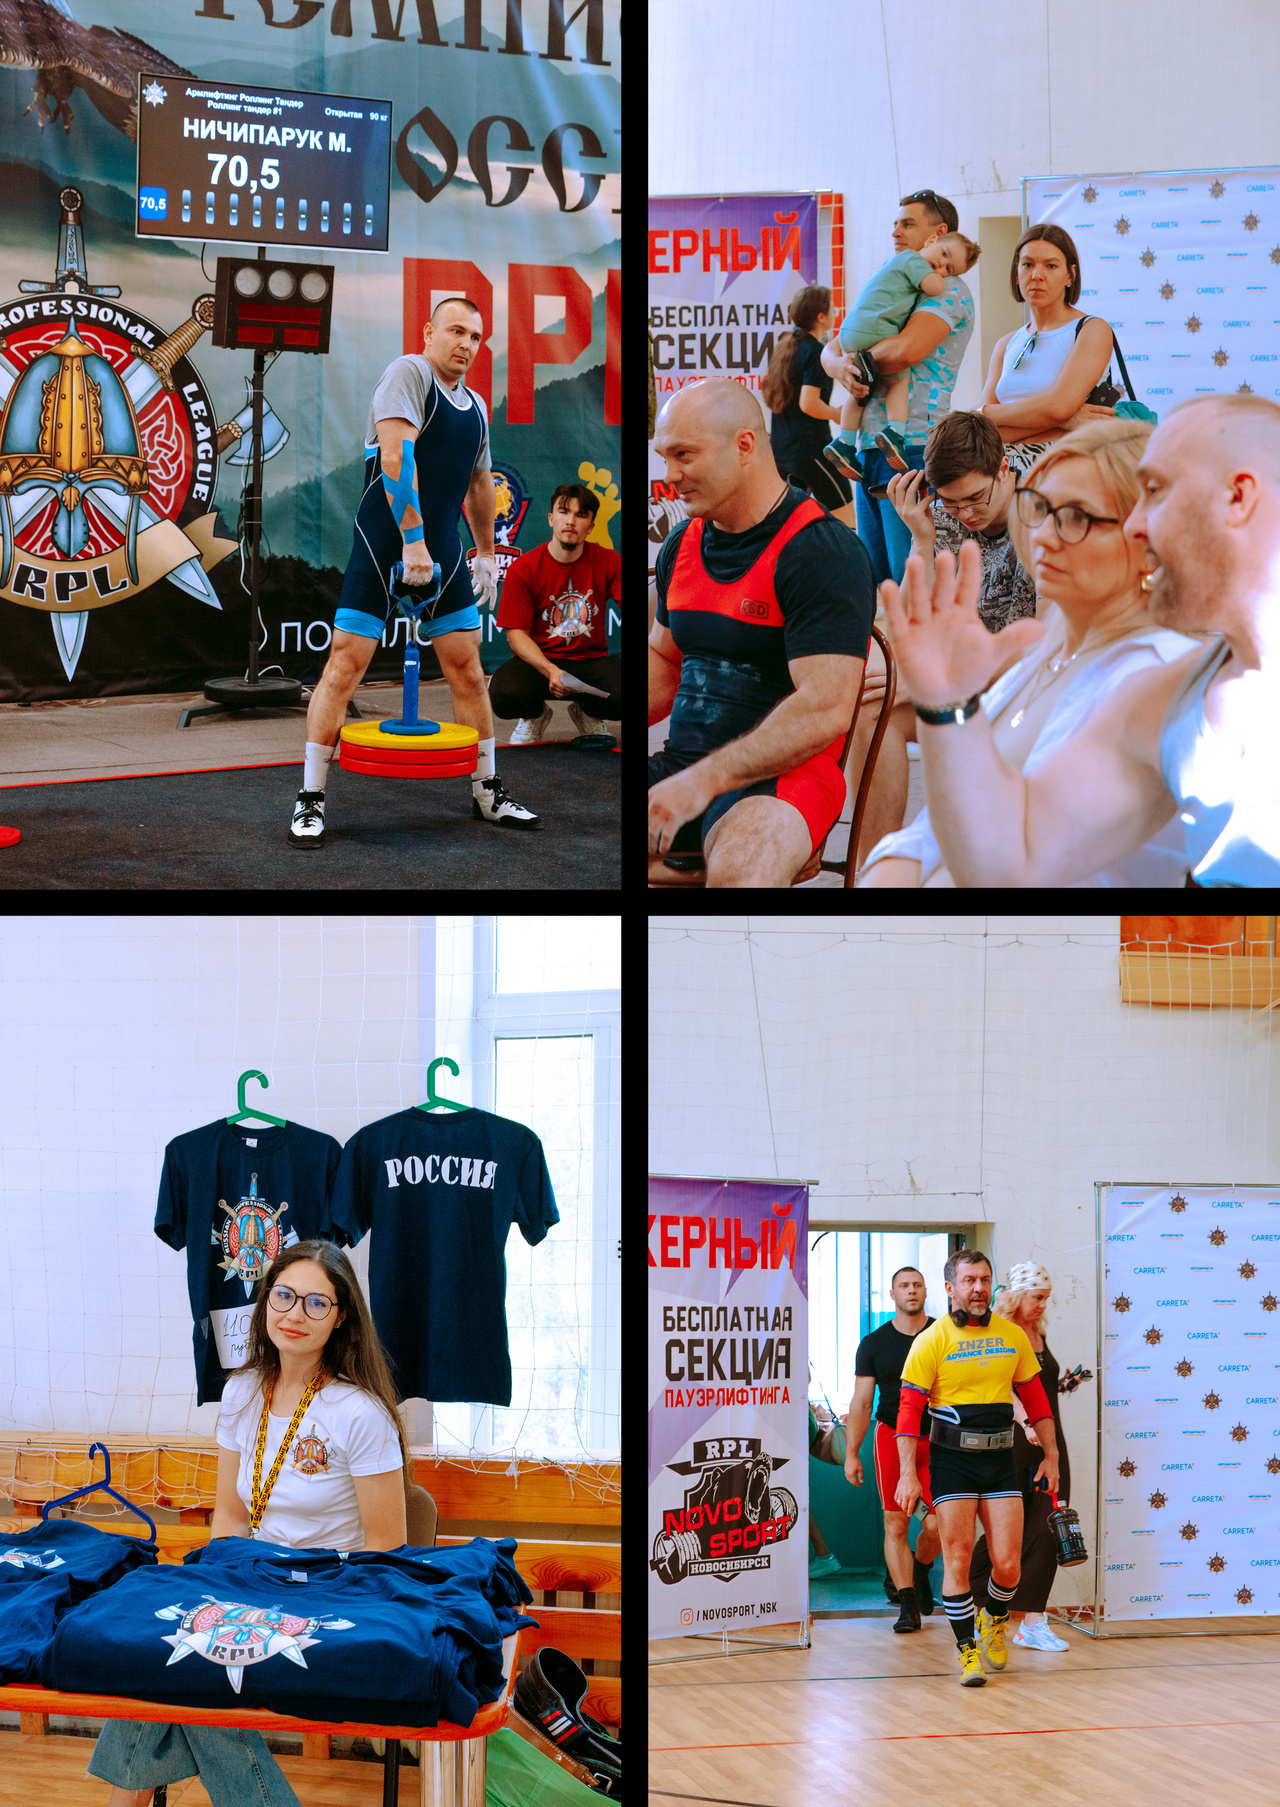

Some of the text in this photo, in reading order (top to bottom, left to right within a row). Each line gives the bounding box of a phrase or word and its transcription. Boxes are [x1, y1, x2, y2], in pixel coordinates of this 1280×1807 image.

[185, 87, 304, 109] Армлифтинг Роллинг Тандер
[207, 100, 282, 117] Роллинг тандер #1
[324, 106, 388, 122] Открытая 90 кг
[183, 117, 352, 153] НИЧИПАРУК М.
[207, 152, 281, 194] 70,5
[1119, 190, 1146, 198] CARRETA
[1247, 184, 1275, 193] CARRETA
[139, 196, 167, 211] 70,5
[1151, 221, 1178, 229] CARRETA
[1176, 253, 1205, 262] CARRETA
[1196, 287, 1225, 295] CARRETA
[650, 304, 793, 328] БЕСПЛАТНА
[1222, 320, 1251, 328] CARRETA
[653, 331, 789, 374] СЕКЦИ
[1250, 354, 1279, 362] CARRETA
[1146, 387, 1174, 395] CARRETA
[0, 299, 207, 502] ROFESSIONAL LEAGUE
[12, 562, 129, 603] RPL
[742, 601, 767, 616] SBD
[386, 1154, 498, 1190] РОССИЯ
[1211, 1201, 1243, 1209] CARRETA
[1134, 1266, 1166, 1275] CARRETA
[1156, 1299, 1188, 1307] CARRETA
[663, 1306, 792, 1332] БЕСПЛАТНАЯ
[1187, 1332, 1219, 1340] CARRETA
[957, 1337, 1004, 1351] INZER
[665, 1338, 791, 1386] СЕКЦИЯ
[945, 1349, 983, 1362] ADVANCE
[1218, 1364, 1250, 1373] CARRETA
[300, 1391, 311, 1408] CROSS
[665, 1386, 790, 1408] ПАУЭРЛИФТИНГА
[1245, 1397, 1277, 1405] CARRETA
[294, 1408, 303, 1419] NOT
[291, 1419, 298, 1428] DO
[282, 1429, 294, 1447] SCENE
[1125, 1431, 1157, 1439] CARRETA
[275, 1447, 286, 1464] CRIME
[706, 1439, 753, 1460] RPL
[256, 1454, 261, 1462] DO
[1161, 1463, 1193, 1471] CARRETA
[267, 1466, 278, 1483] CROSS
[263, 1483, 271, 1494] NOT
[260, 1493, 267, 1502] DO
[1192, 1495, 1224, 1503] CARRETA
[252, 1503, 264, 1521] SCENE
[665, 1496, 743, 1537] NOVO
[709, 1515, 792, 1558] SPORT
[1223, 1527, 1254, 1535] CARRETA
[690, 1558, 770, 1574] НОВОСИБИРСК
[1130, 1595, 1162, 1603] CARRETA
[702, 1601, 778, 1621] NOVOSPORT_NSK
[210, 1645, 262, 1662] RPL
